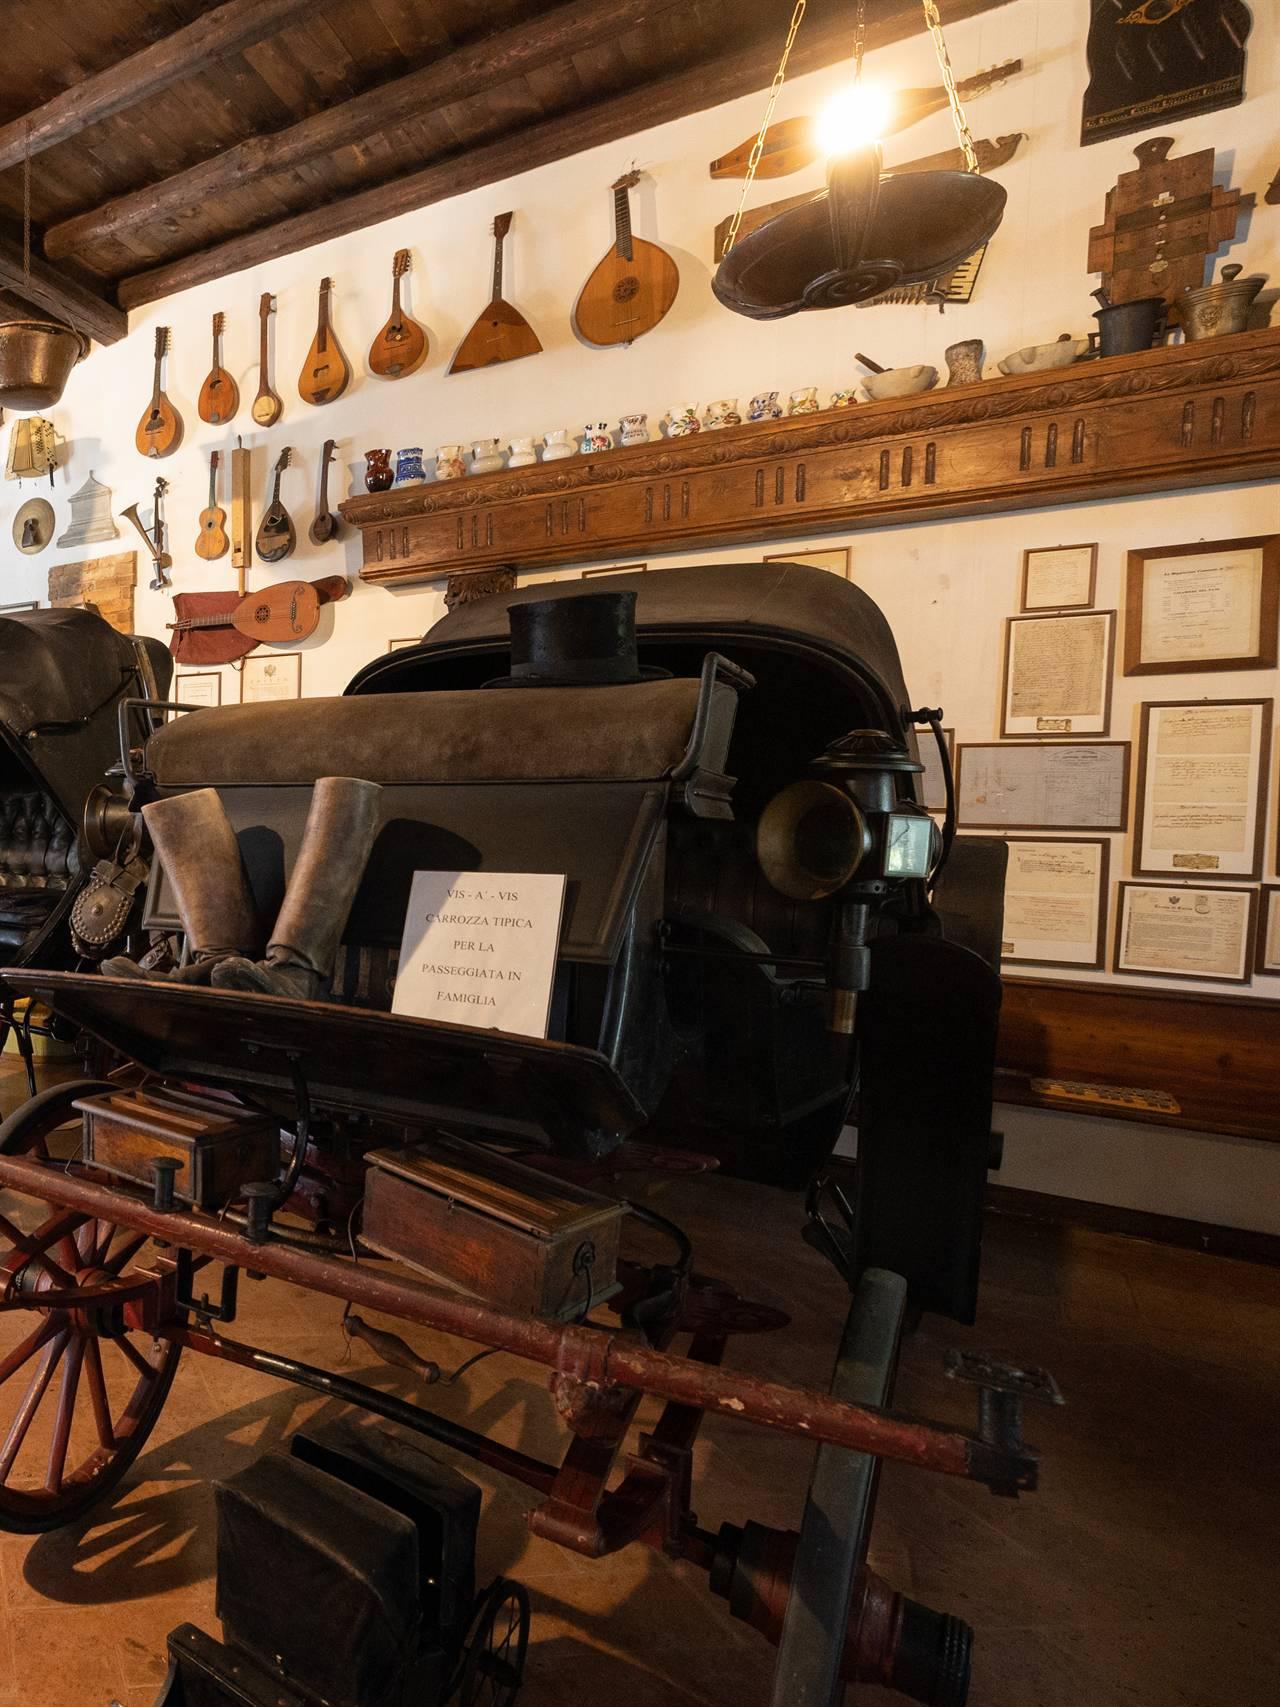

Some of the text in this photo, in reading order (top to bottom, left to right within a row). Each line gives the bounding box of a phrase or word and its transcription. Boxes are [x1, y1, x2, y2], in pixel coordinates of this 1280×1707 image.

[447, 889, 465, 899] VIS
[498, 891, 519, 901] VIS
[425, 913, 533, 928] CARROZZA TIPICA
[453, 940, 495, 952] PER LA
[422, 963, 522, 981] PASSEGGIATA IN
[436, 991, 496, 1006] FAMIGLIA
